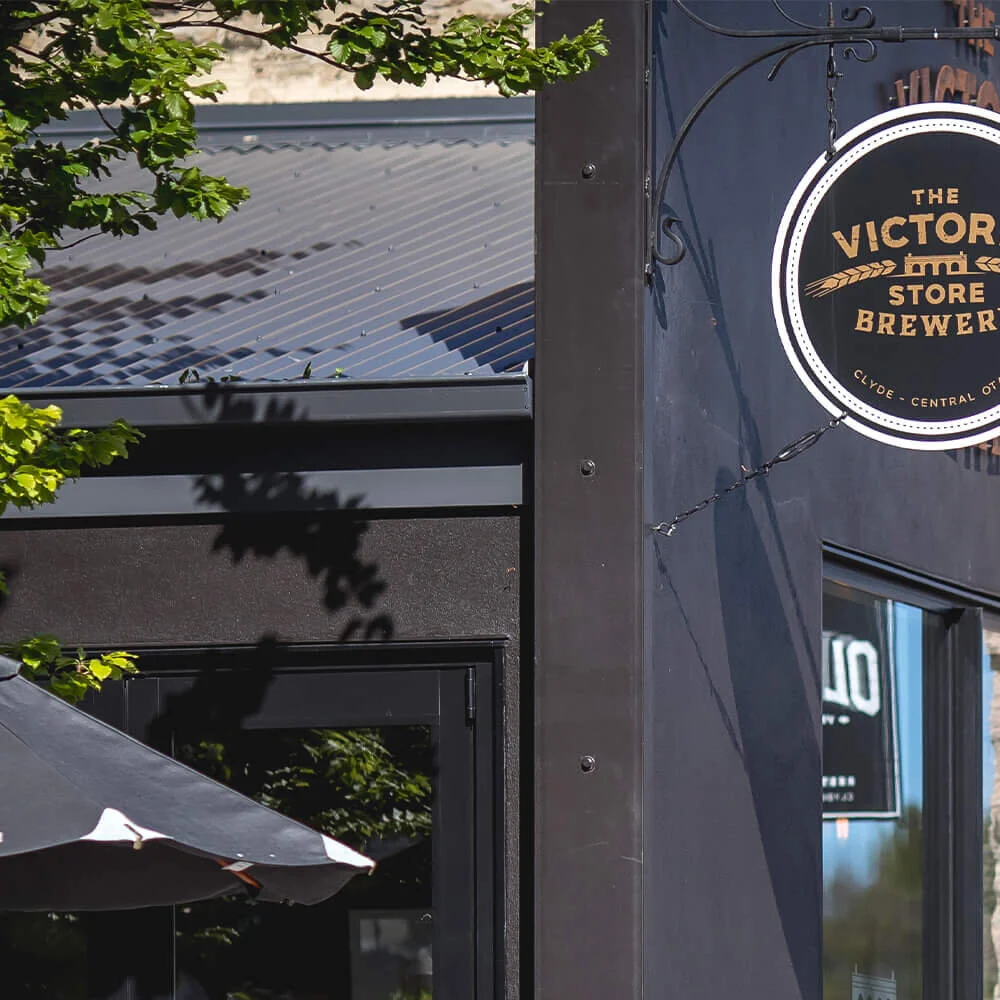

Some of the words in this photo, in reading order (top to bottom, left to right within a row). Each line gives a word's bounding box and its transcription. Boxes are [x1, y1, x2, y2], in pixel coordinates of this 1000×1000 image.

[911, 187, 959, 206] THE
[888, 282, 985, 306] STORE
[854, 369, 895, 399] CLYDE
[911, 392, 976, 408] CENTRAL
